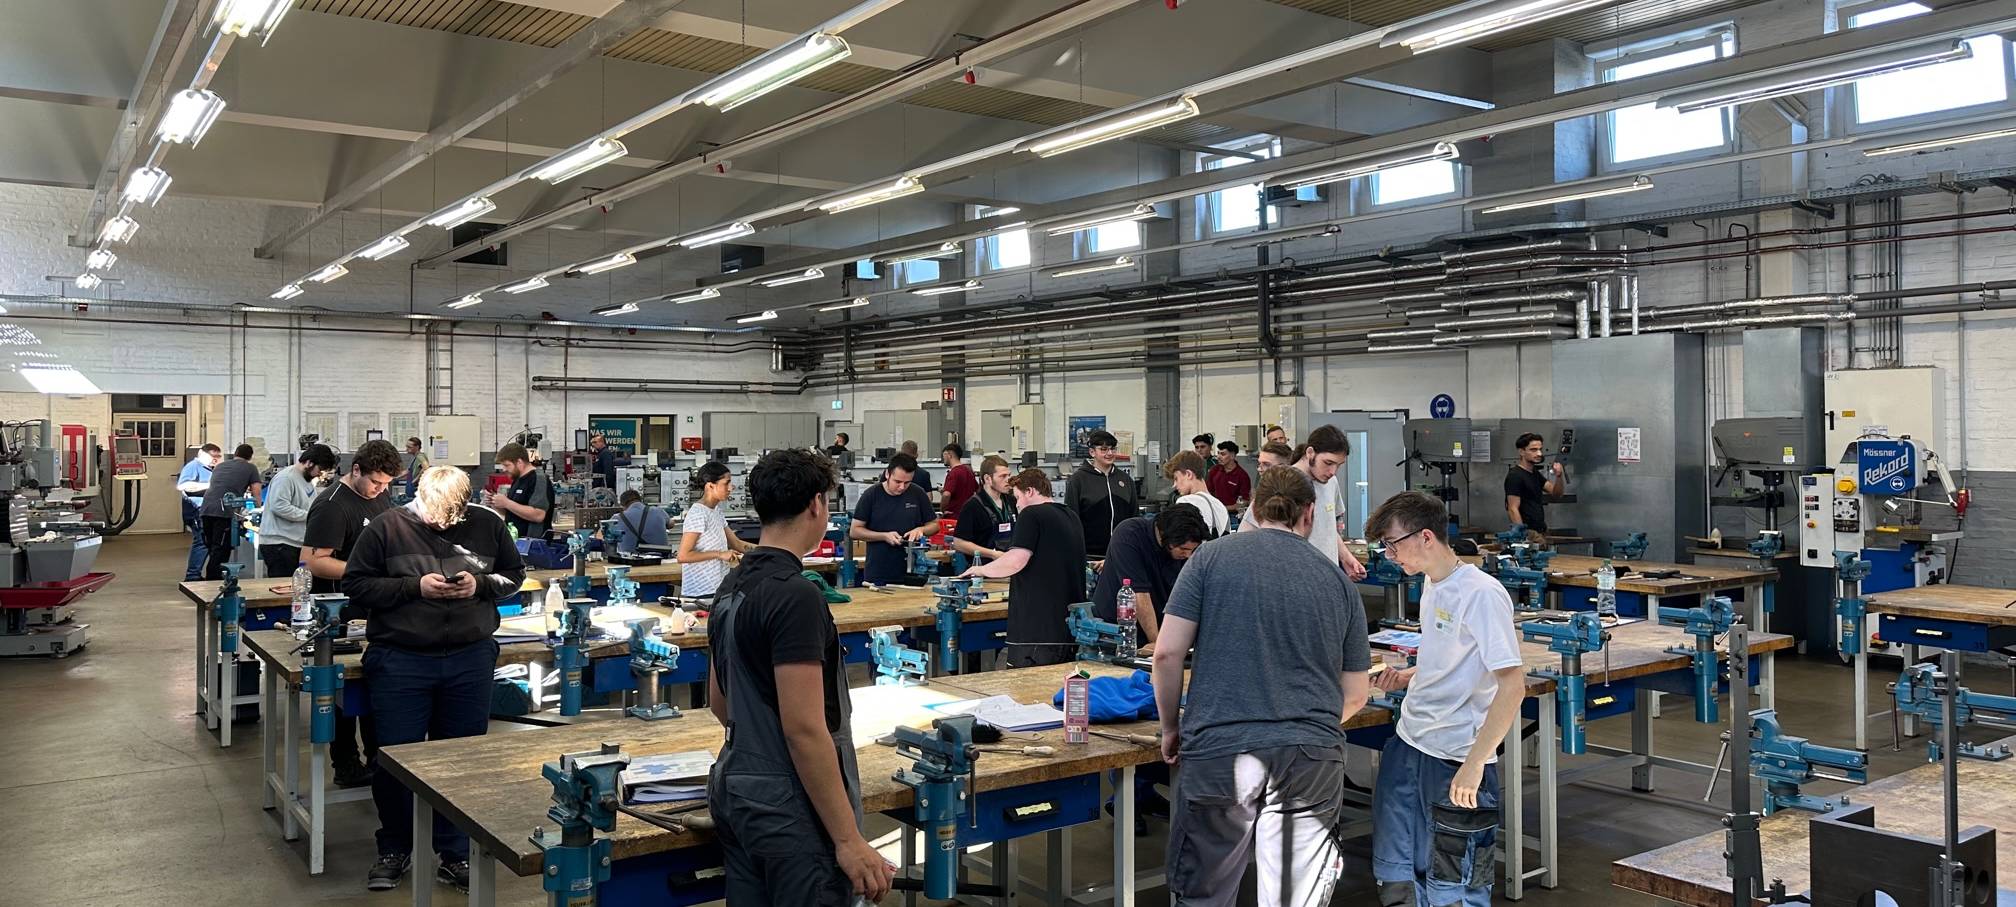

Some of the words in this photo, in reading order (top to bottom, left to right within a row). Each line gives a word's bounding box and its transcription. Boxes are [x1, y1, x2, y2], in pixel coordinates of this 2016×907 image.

[605, 437, 637, 445] WERDEN
[1863, 448, 1897, 457] Mössner
[1864, 447, 1909, 486] Rekord
